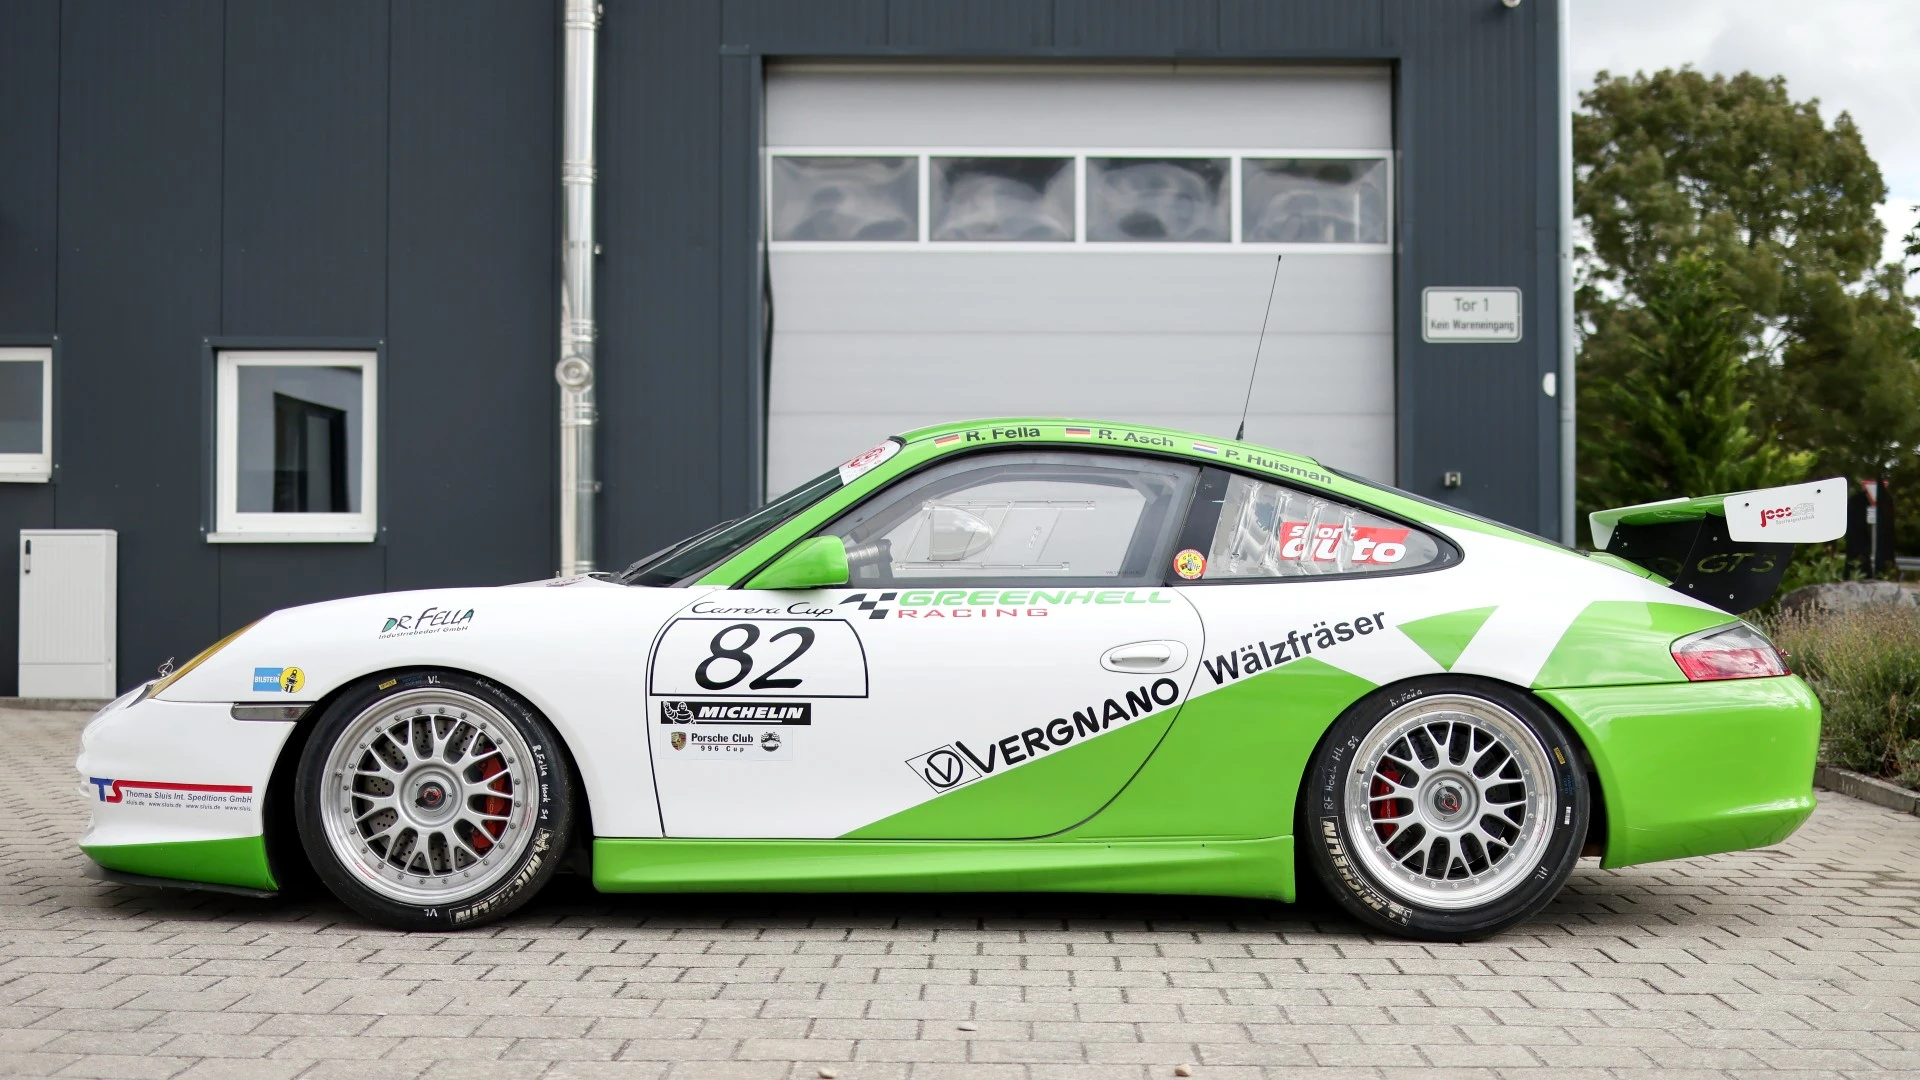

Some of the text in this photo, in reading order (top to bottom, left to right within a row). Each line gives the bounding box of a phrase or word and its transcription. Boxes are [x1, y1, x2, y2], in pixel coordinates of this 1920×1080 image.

[1454, 297, 1489, 312] Tor 1
[1431, 320, 1515, 333] Kein Wareneingang
[965, 427, 1041, 442] R. Fella
[1098, 429, 1174, 447] R. Asch
[1225, 449, 1332, 484] P. Huisman
[1281, 538, 1406, 562] auto
[898, 590, 1172, 606] GREENHELL
[691, 601, 834, 617] Carrera Cup
[898, 608, 1049, 618] RACING
[381, 614, 412, 633] DR.
[378, 625, 468, 639] Industriebedarf GmbH
[1203, 611, 1385, 685] Wälzfräser
[694, 623, 816, 690] 82
[254, 675, 280, 684] BILSTEIN
[427, 675, 441, 685] VL
[698, 706, 805, 719] MICHELIN
[955, 677, 1180, 774] VERGNANO
[691, 732, 754, 743] Porsche Club
[726, 745, 745, 753] Cup
[89, 776, 124, 803] TS
[125, 790, 253, 803] Thomas Sluis Int. Speditions GmbH
